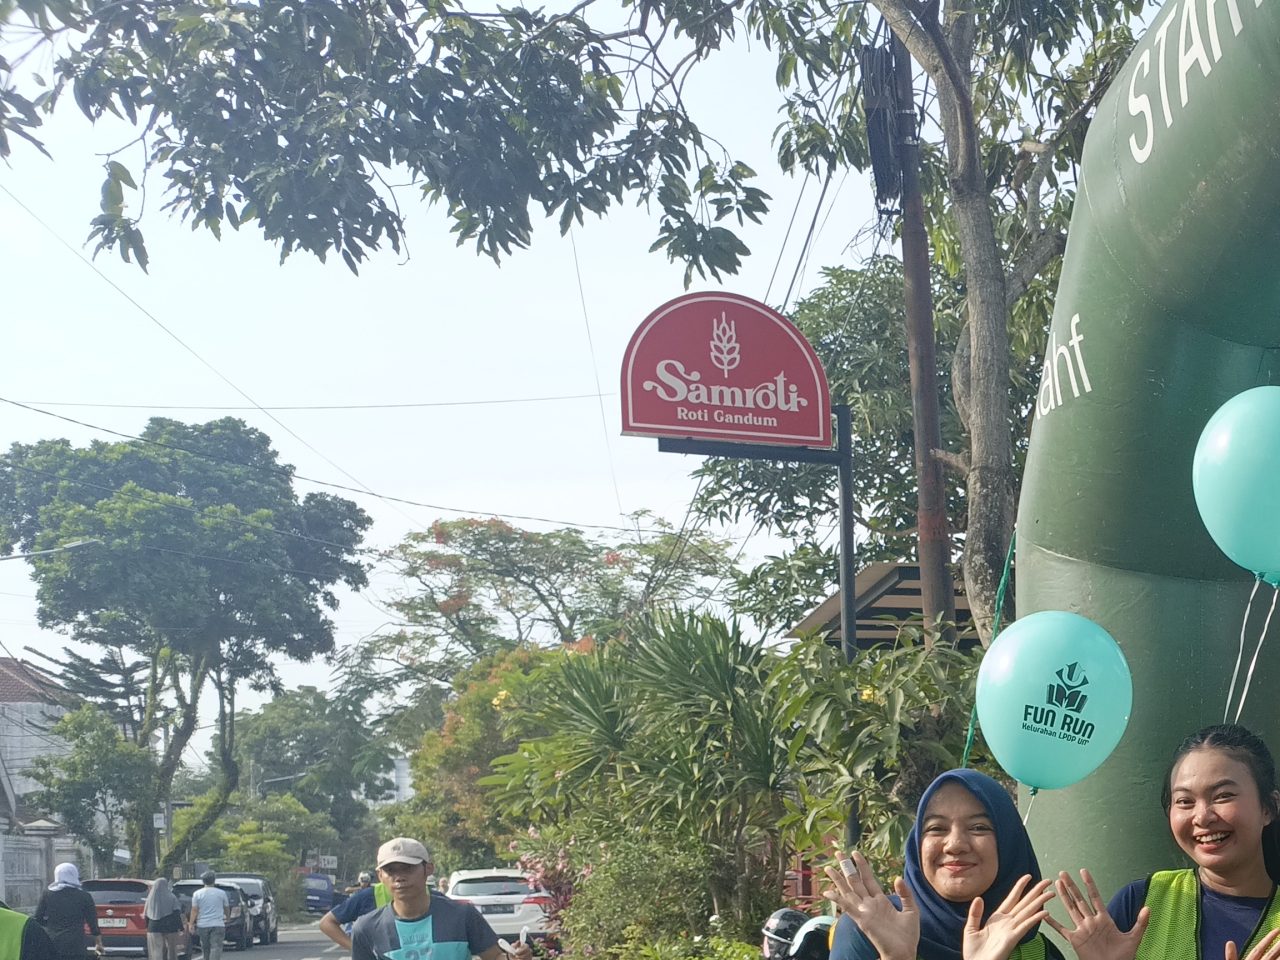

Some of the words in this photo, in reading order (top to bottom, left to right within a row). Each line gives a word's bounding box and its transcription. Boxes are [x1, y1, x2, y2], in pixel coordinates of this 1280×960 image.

[1128, 0, 1263, 164] STA
[643, 359, 808, 412] Samroti
[1035, 312, 1093, 420] ahf
[677, 406, 708, 422] Roti
[713, 409, 778, 427] Gandum
[1021, 722, 1057, 738] Kelurahan
[1058, 731, 1077, 743] LPDP
[1023, 704, 1057, 728] FUN
[1060, 713, 1095, 740] RUN
